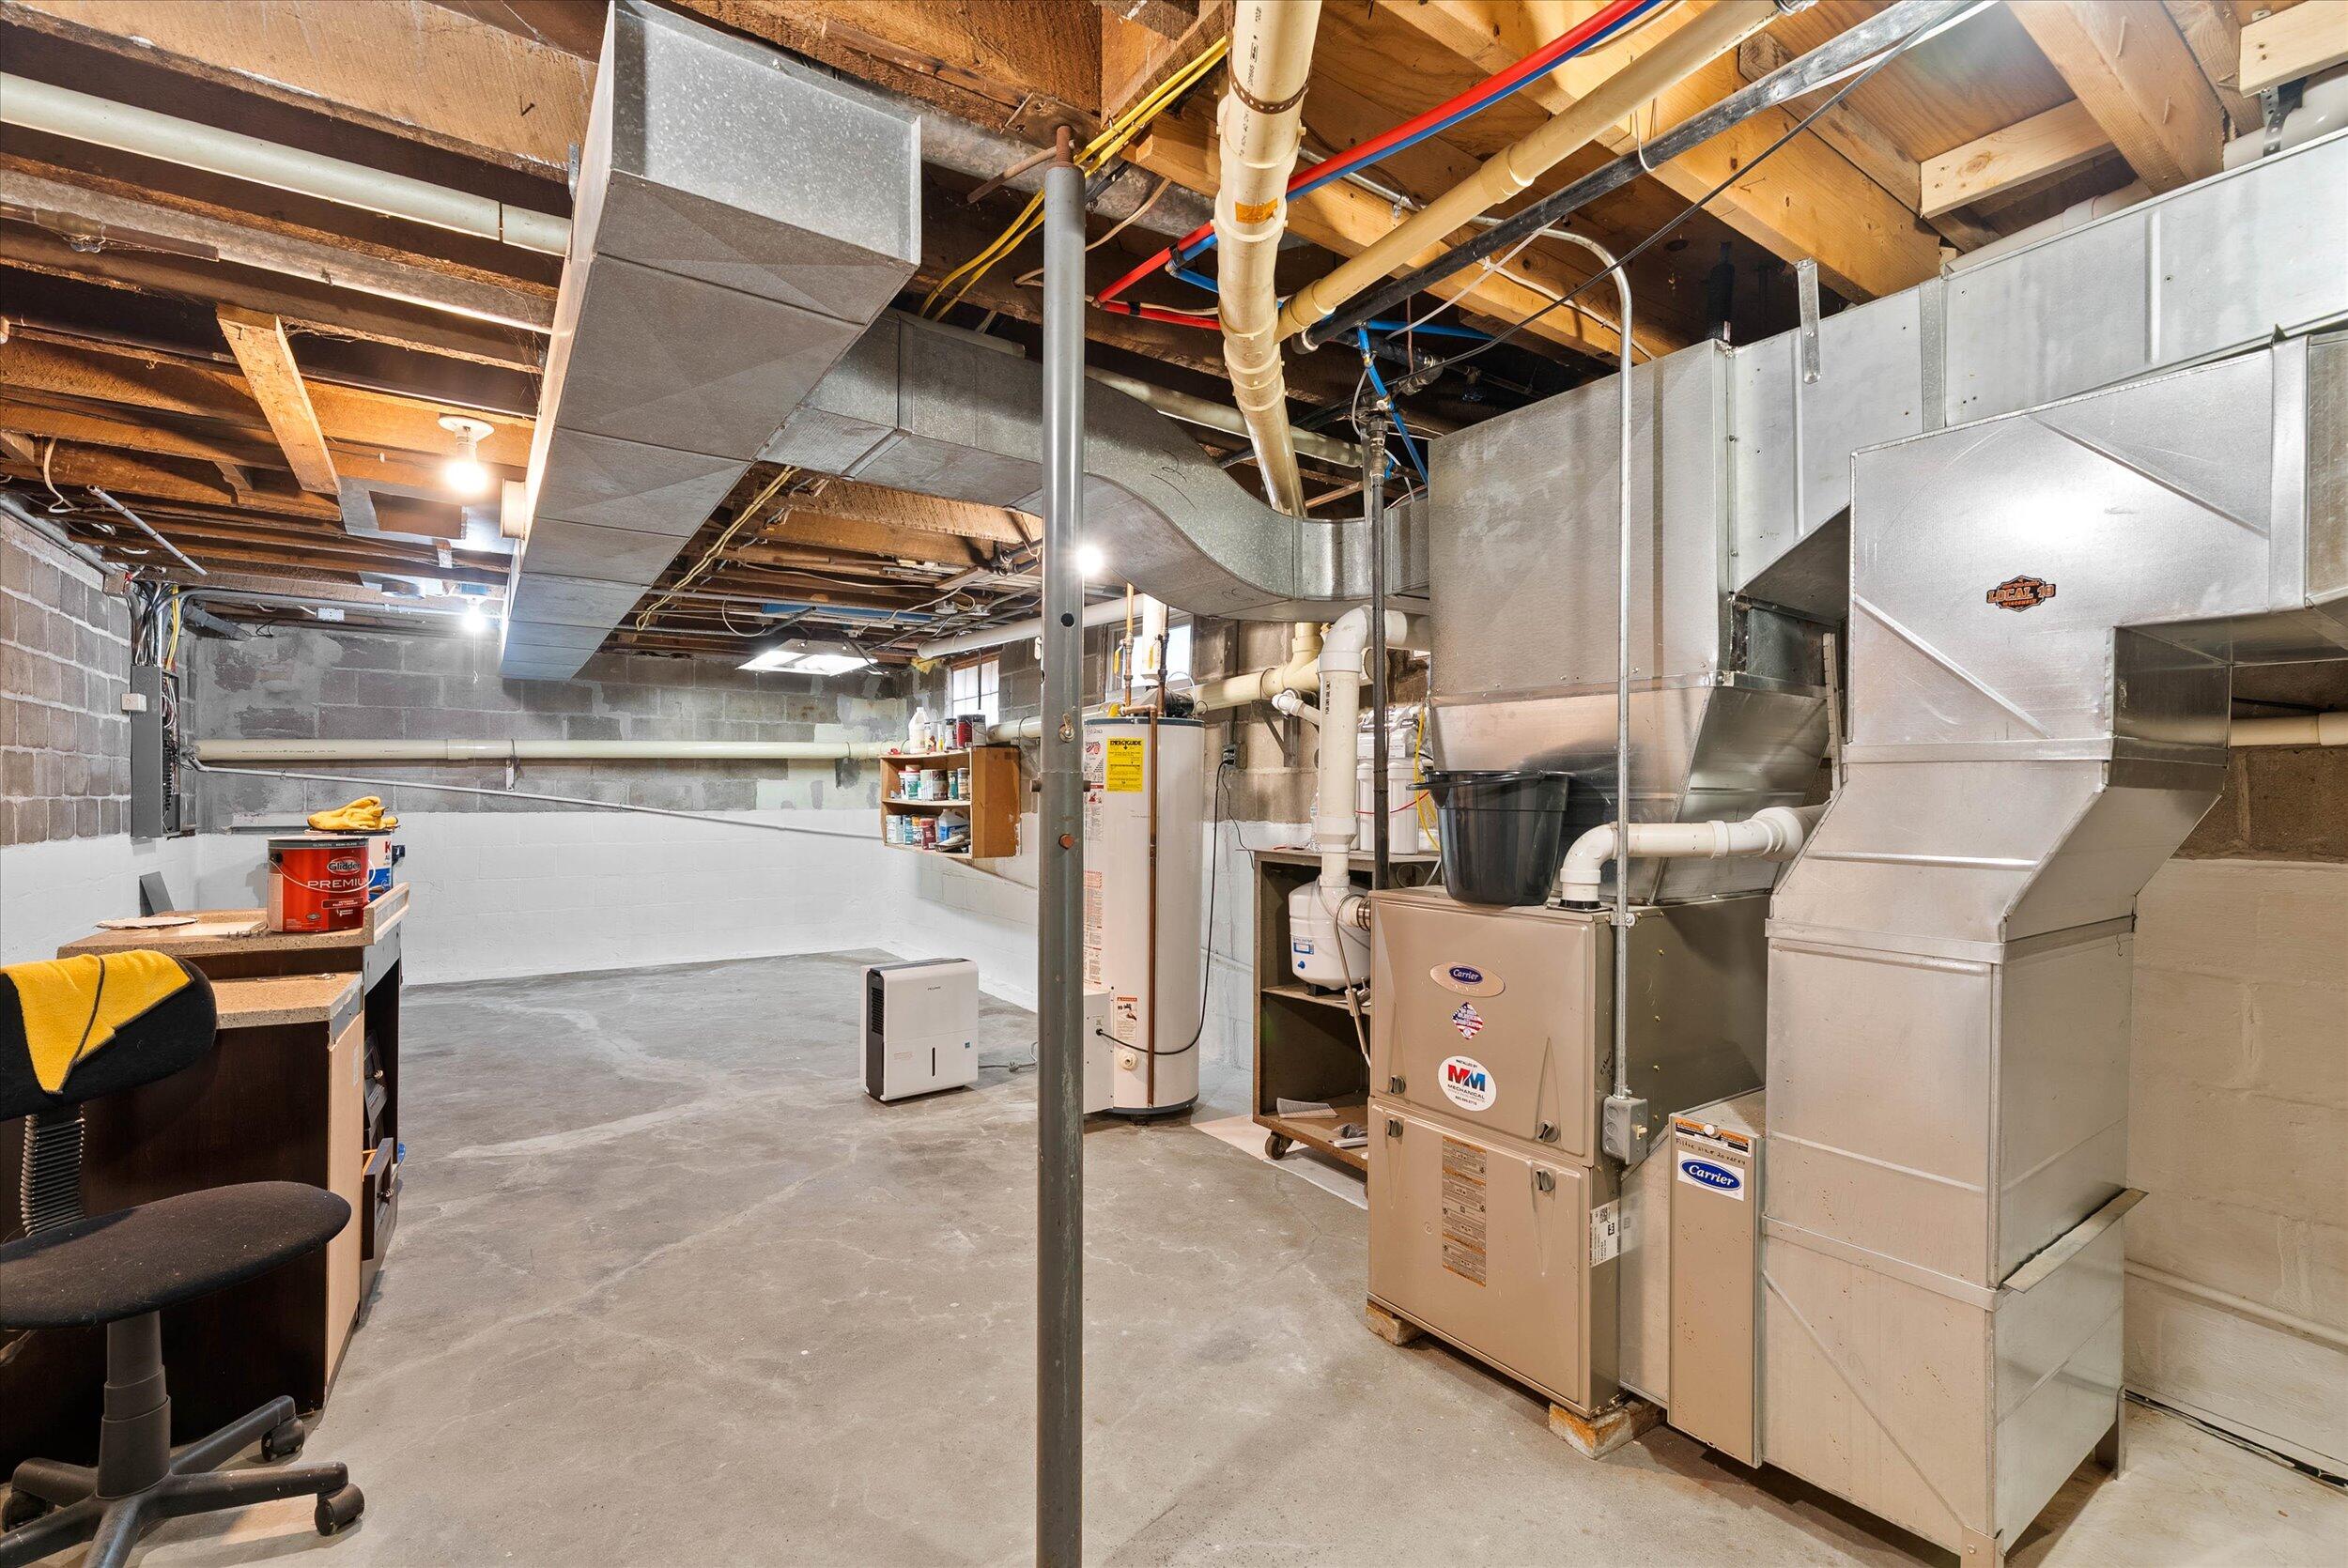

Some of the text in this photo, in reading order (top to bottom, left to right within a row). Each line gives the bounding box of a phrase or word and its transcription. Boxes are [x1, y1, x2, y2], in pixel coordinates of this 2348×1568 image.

[1988, 587, 2033, 602] LOCAL
[1453, 969, 1479, 980] Carrier
[1447, 1084, 1486, 1099] MECHANICAL
[1689, 1165, 1734, 1186] Carrier
